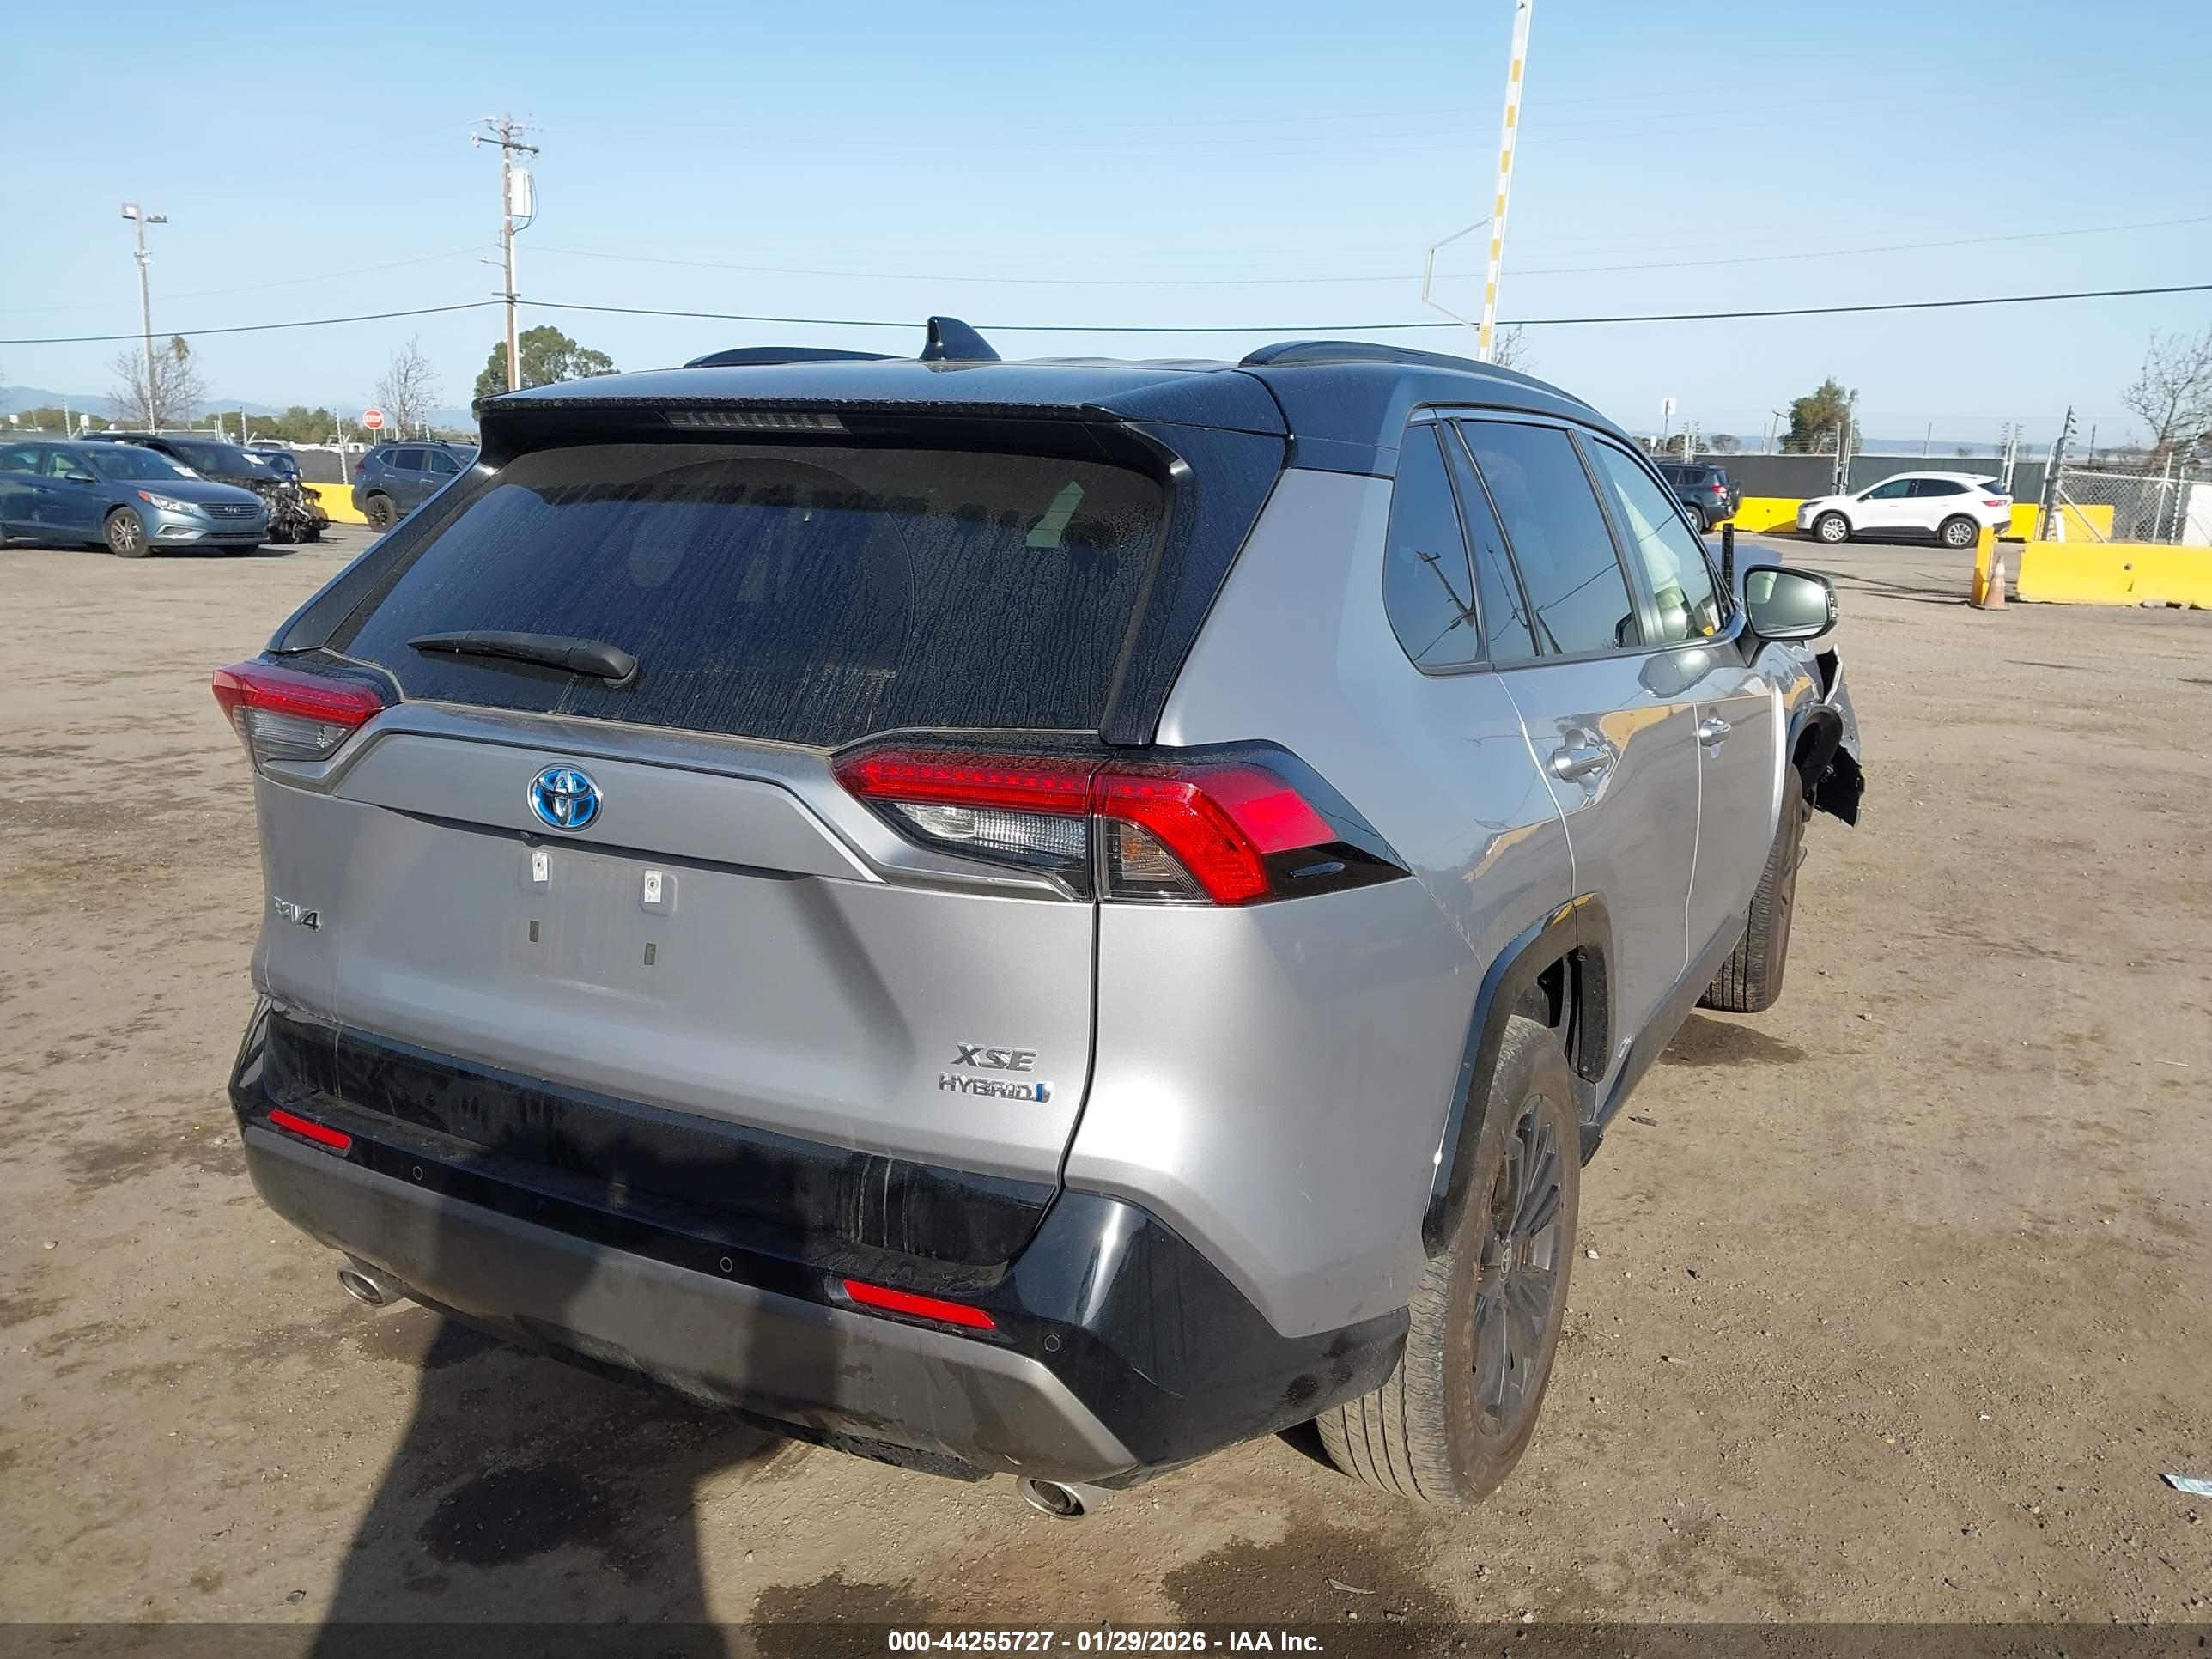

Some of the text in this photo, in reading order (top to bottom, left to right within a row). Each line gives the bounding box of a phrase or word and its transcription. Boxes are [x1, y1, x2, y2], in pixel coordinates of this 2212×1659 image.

[363, 414, 383, 423] STOP
[950, 1042, 1038, 1072] XSE
[939, 1072, 1033, 1102] HYBRID
